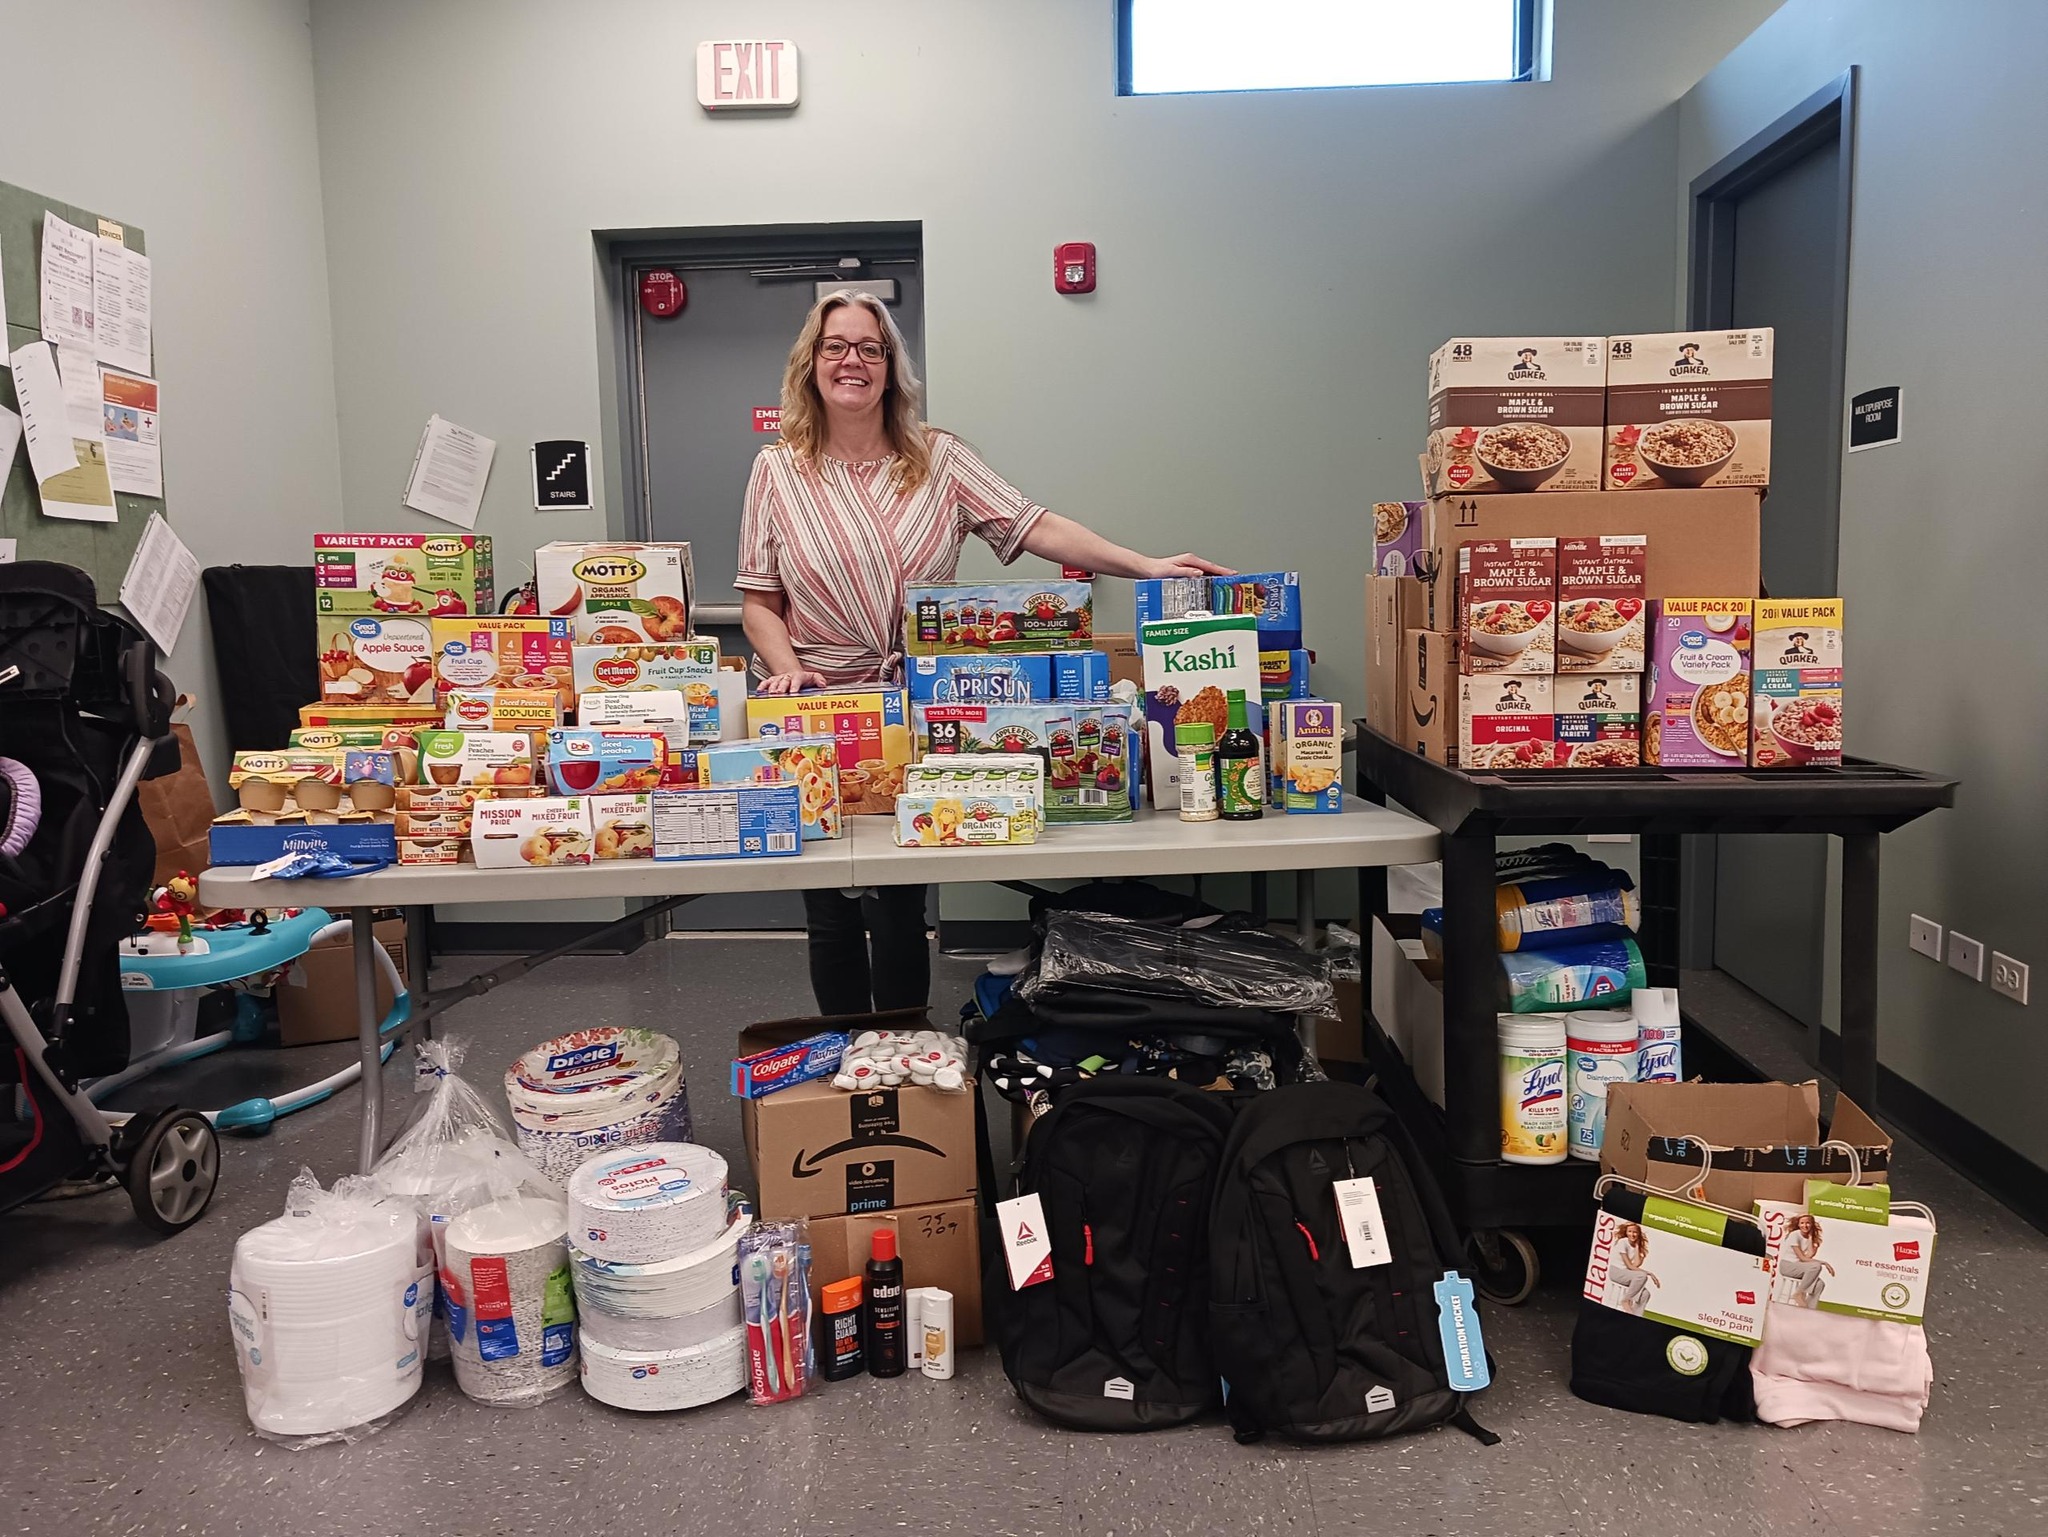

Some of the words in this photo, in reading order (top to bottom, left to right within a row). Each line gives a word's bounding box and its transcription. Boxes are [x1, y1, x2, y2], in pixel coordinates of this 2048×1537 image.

[713, 42, 784, 100] EXIT
[649, 272, 671, 281] STOP
[1453, 344, 1472, 356] 48
[1612, 342, 1632, 354] 48
[1507, 370, 1546, 381] QUAKER
[1669, 366, 1709, 377] QUAKER
[1671, 394, 1699, 402] MAPLE
[1497, 406, 1526, 414] BROWN
[1528, 406, 1554, 414] SUGAR
[1659, 402, 1690, 411] BROWN
[1691, 401, 1718, 409] SUGAR
[1855, 398, 1893, 415] MULTIPURPOSE
[1866, 412, 1882, 423] ROOM
[763, 421, 781, 430] EXI
[550, 491, 576, 499] STAIRS
[322, 537, 376, 546] VARIETY
[380, 537, 414, 546] PACK
[425, 542, 463, 552] MOTT'S
[318, 566, 325, 575] 3
[581, 564, 637, 576] MOTT'S
[1489, 569, 1525, 577] MAPLE
[1528, 568, 1536, 577] &
[1578, 566, 1615, 575] MAPLE
[1618, 566, 1626, 575] &
[1473, 578, 1514, 587] BROWN
[1517, 577, 1552, 586] SUGAR
[1562, 576, 1603, 585] BROWN
[1606, 575, 1642, 584] SUGAR
[592, 586, 629, 594] ORGANIC
[921, 605, 937, 615] 32
[1668, 602, 1698, 612] VALUE
[1701, 602, 1729, 612] PACK
[1731, 602, 1743, 612] 20
[1762, 608, 1773, 619] 20
[1782, 607, 1809, 618] VALUE
[1812, 606, 1836, 617] PACK
[551, 621, 564, 631] 12
[1668, 618, 1680, 626] 20
[383, 632, 424, 641] Unsweetened
[1145, 629, 1172, 638] FAMILY
[1173, 627, 1190, 635] SIZE
[362, 643, 391, 654] Apple
[394, 643, 425, 652] Sauce
[700, 651, 710, 659] 12
[1163, 645, 1237, 673] Kashi
[1680, 653, 1697, 661] Fruit
[1698, 653, 1704, 661] &
[1705, 653, 1733, 661] Cream
[1780, 654, 1819, 665] QUAKER
[467, 658, 483, 666] Cup
[1681, 661, 1709, 670] Variety
[1711, 661, 1731, 669] Pack
[598, 667, 610, 675] Del
[610, 666, 637, 675] Monte
[648, 667, 666, 675] Fruit
[668, 666, 685, 675] Cup
[686, 666, 713, 674] Snacks
[583, 698, 601, 706] fresh
[796, 701, 828, 711] VALUE
[831, 700, 859, 709] PACK
[885, 697, 901, 708] 24
[1495, 701, 1531, 712] QUAKER
[1578, 700, 1616, 710] QUAKER
[932, 723, 956, 737] 36
[1297, 726, 1332, 735] Annie's
[302, 735, 339, 744] MOTT'S
[434, 742, 454, 750] fresh
[571, 742, 590, 750] Dole
[1295, 741, 1333, 749] ORGANIC
[601, 747, 632, 755] peaches
[683, 753, 695, 763] 12
[480, 809, 521, 819] MISSION
[601, 806, 624, 815] MIXED
[626, 805, 647, 813] FRUIT
[532, 812, 556, 821] MIXED
[557, 812, 580, 820] FRUIT
[490, 818, 511, 826] PRIDE
[962, 821, 1002, 829] ORGANICS
[282, 839, 328, 851] Millville
[753, 1055, 800, 1077] Colgate
[1638, 1047, 1676, 1078] Lysol
[564, 1061, 610, 1077] ULTRA
[1523, 1064, 1563, 1096] Lysol
[625, 1121, 660, 1138] ULTRA
[1582, 1129, 1593, 1139] 75
[610, 1176, 659, 1191] Plates
[615, 1181, 661, 1195] Everyday
[850, 1198, 887, 1213] prime
[1814, 1199, 1845, 1209] organically
[1845, 1203, 1863, 1211] grown
[1864, 1205, 1883, 1213] cotton
[1648, 1214, 1679, 1228] organically
[1679, 1221, 1698, 1232] grown
[1698, 1224, 1717, 1236] cotton
[1016, 1237, 1037, 1247] Reebok
[1583, 1214, 1616, 1304] Hanes
[1855, 1258, 1872, 1267] rest
[1874, 1261, 1919, 1274] essentials
[873, 1285, 900, 1299] edge
[874, 1305, 899, 1313] SENSITIVE
[1450, 1295, 1465, 1328] POCKET
[1721, 1310, 1754, 1324] TAGLESS
[835, 1314, 856, 1331] RIGHT
[1697, 1312, 1727, 1328] sleep
[1729, 1320, 1754, 1333] pant
[835, 1325, 857, 1340] GUARD
[1456, 1328, 1474, 1379] HYDRATION
[754, 1349, 766, 1396] Colgate
